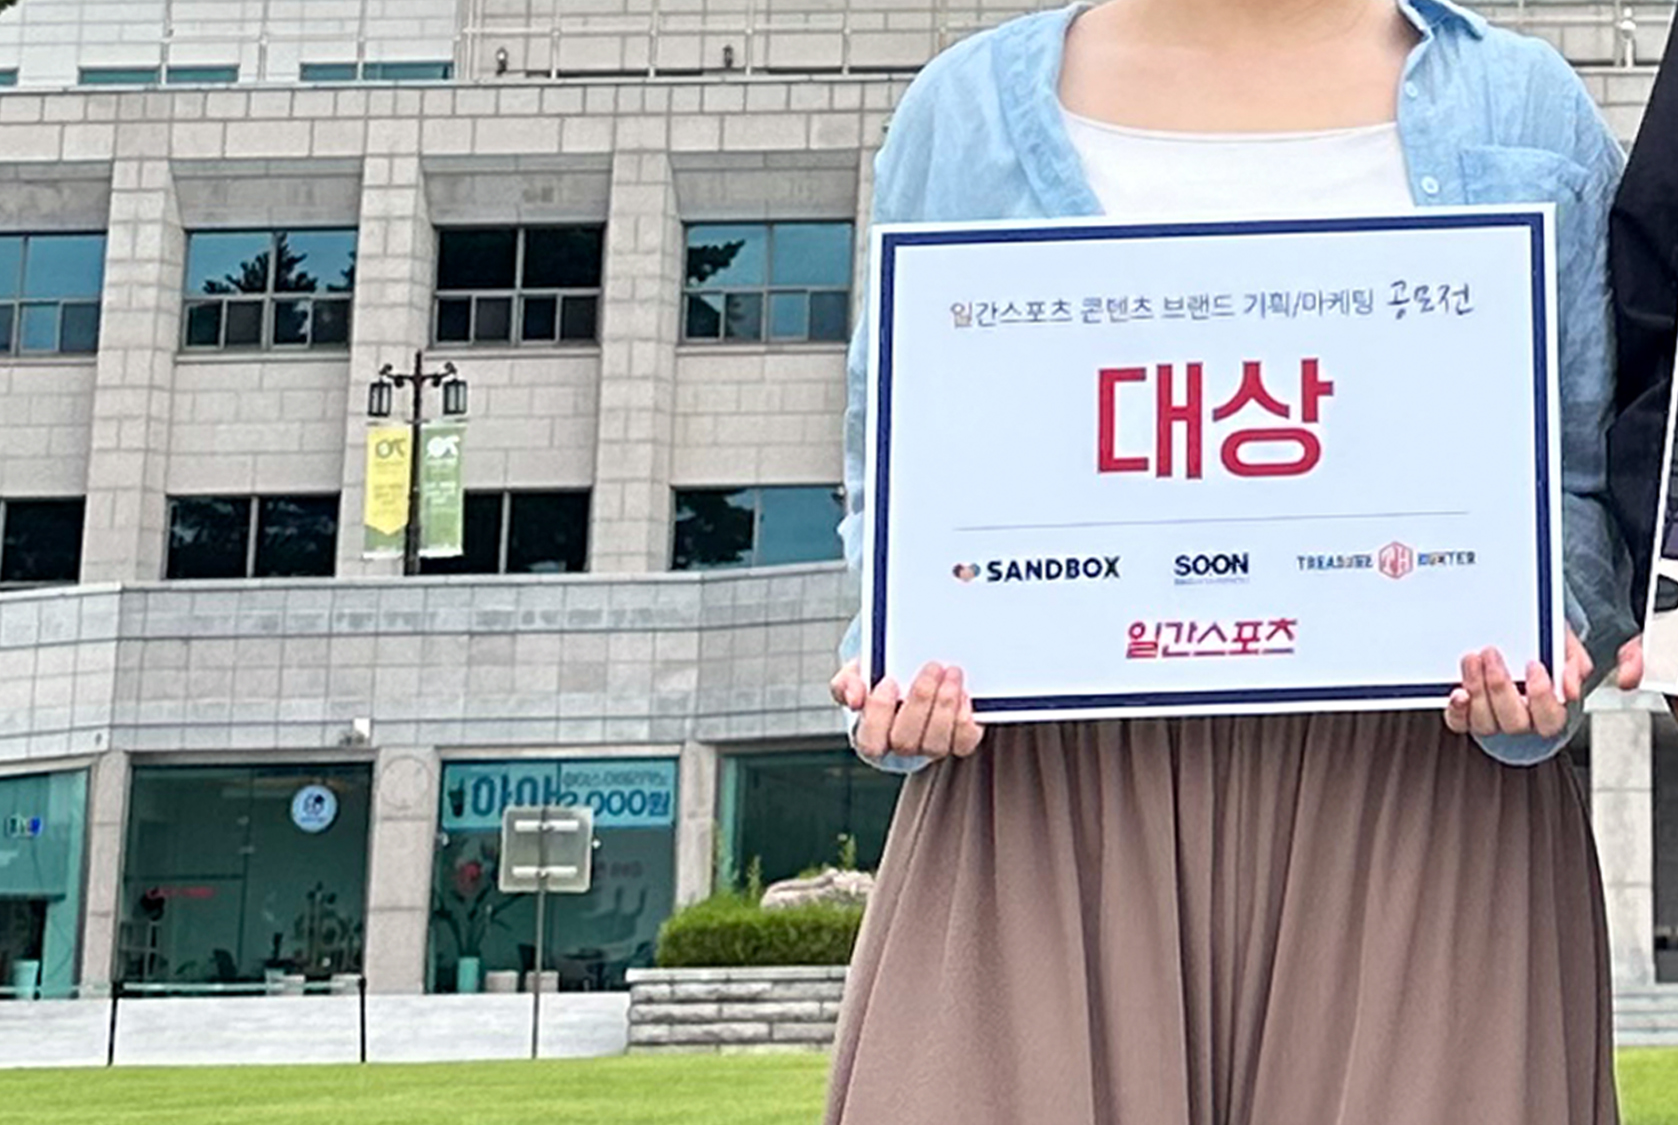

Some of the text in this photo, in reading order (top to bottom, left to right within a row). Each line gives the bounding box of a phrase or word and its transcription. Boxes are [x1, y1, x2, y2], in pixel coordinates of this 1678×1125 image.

[949, 279, 1474, 329] 일간스포츠 콘텐츠 브랜드 기획/마케팅 공모전
[1097, 357, 1334, 480] 대상
[986, 556, 1120, 583] SANDBOX
[1174, 552, 1249, 576] SOON
[1125, 617, 1297, 660] 일간스포츠
